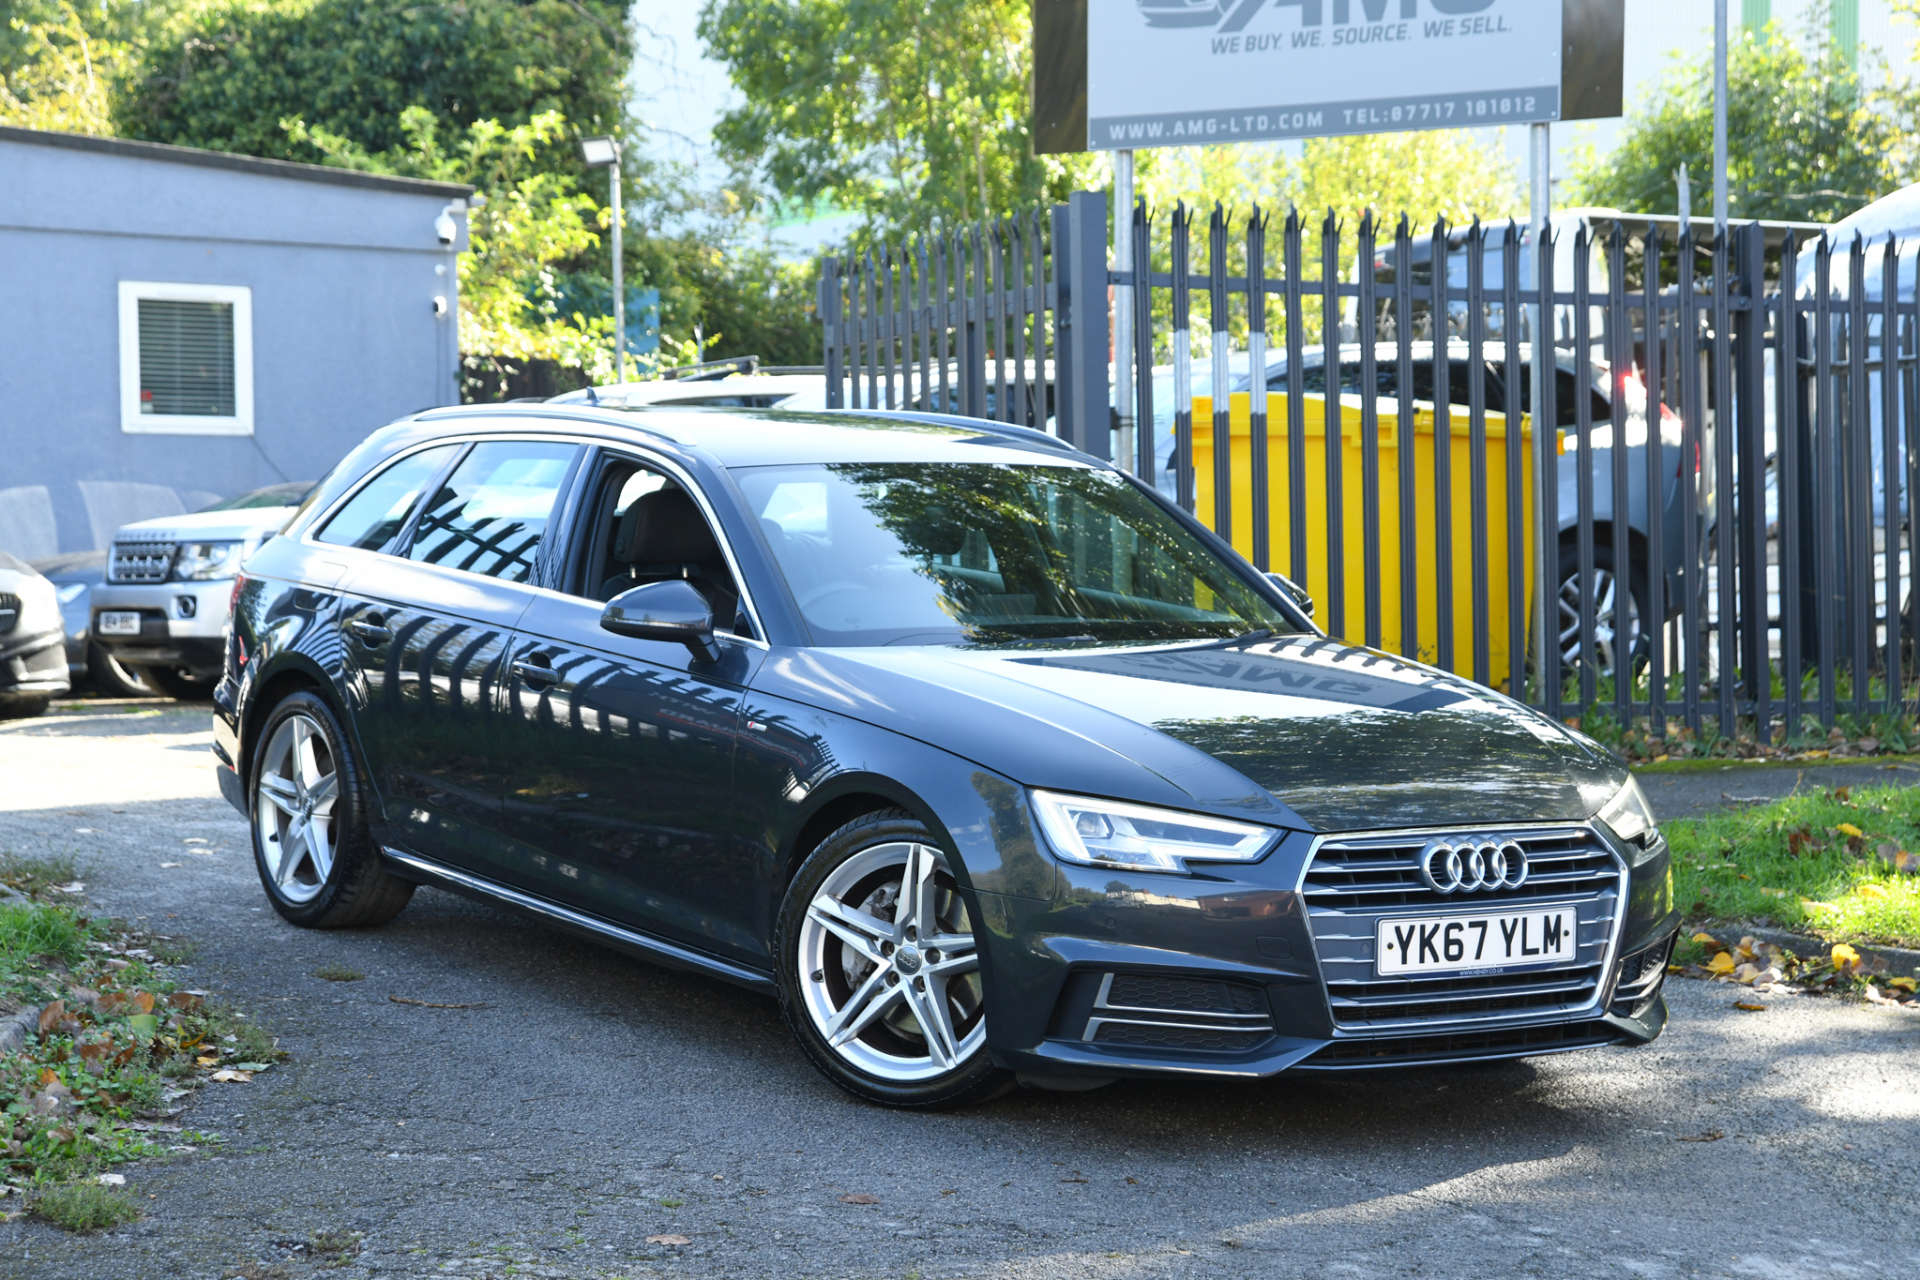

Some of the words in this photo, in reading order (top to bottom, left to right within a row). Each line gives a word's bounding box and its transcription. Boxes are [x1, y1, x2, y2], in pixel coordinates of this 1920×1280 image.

[1211, 36, 1241, 55] WE
[1332, 23, 1412, 46] SOURCE.
[1424, 19, 1455, 38] WE
[1459, 15, 1513, 36] SELL.
[1109, 110, 1324, 140] WWW.AMG-LTD.COM
[1394, 920, 1489, 965] YK67
[1500, 914, 1562, 957] YLM
